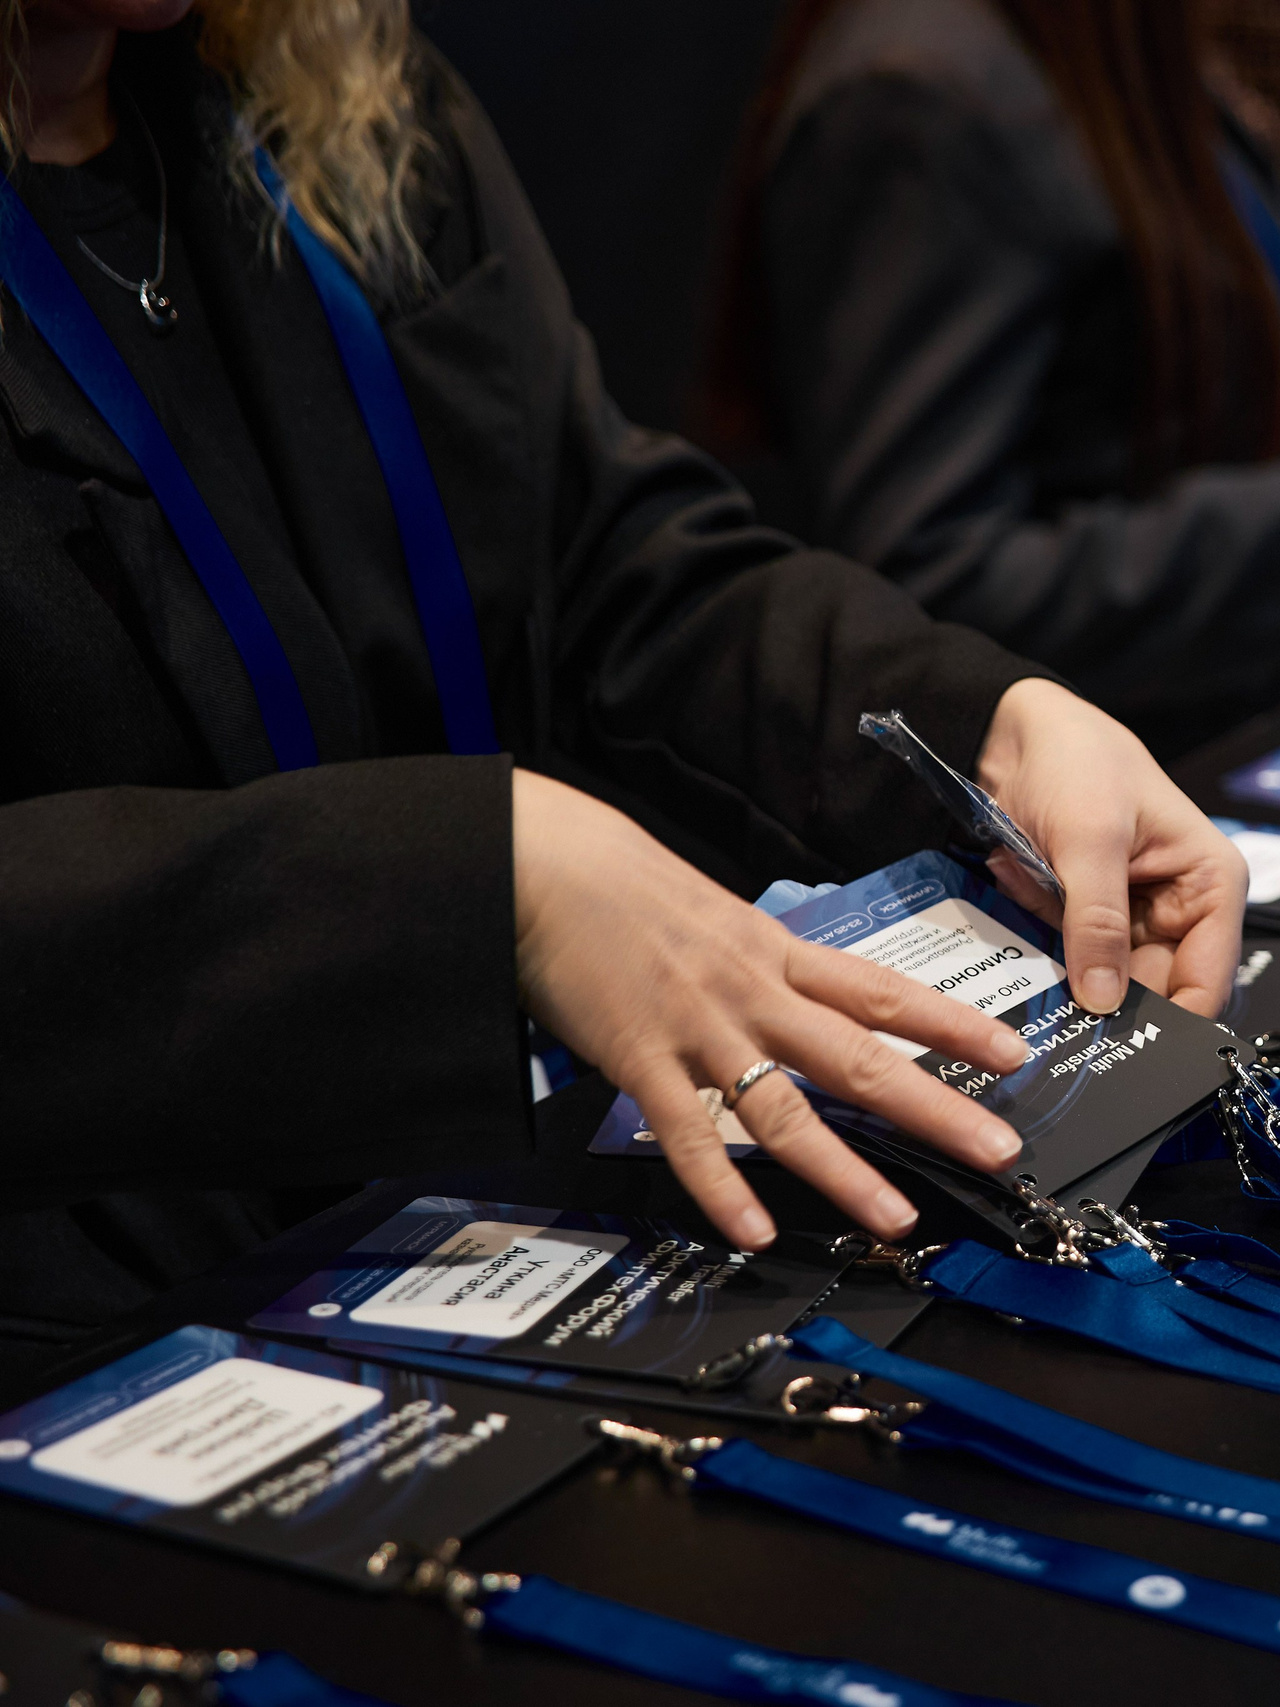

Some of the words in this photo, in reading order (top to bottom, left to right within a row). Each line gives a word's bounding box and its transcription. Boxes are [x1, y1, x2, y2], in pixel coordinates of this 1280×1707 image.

[879, 885, 935, 914] МУРМАНСК
[903, 936, 973, 972] Руководитель
[997, 976, 1032, 997] ПАО
[1049, 1036, 1121, 1078] Transfer
[1088, 1044, 1135, 1075] Multi
[441, 1245, 530, 1306] Анастасия
[573, 1248, 603, 1267] ООО
[608, 1239, 679, 1292] Финтех
[704, 1263, 742, 1288] Multi
[484, 1259, 550, 1300] Уткина
[585, 1241, 705, 1338] Арктический
[666, 1263, 712, 1303] Transfer
[543, 1294, 617, 1346] Форум
